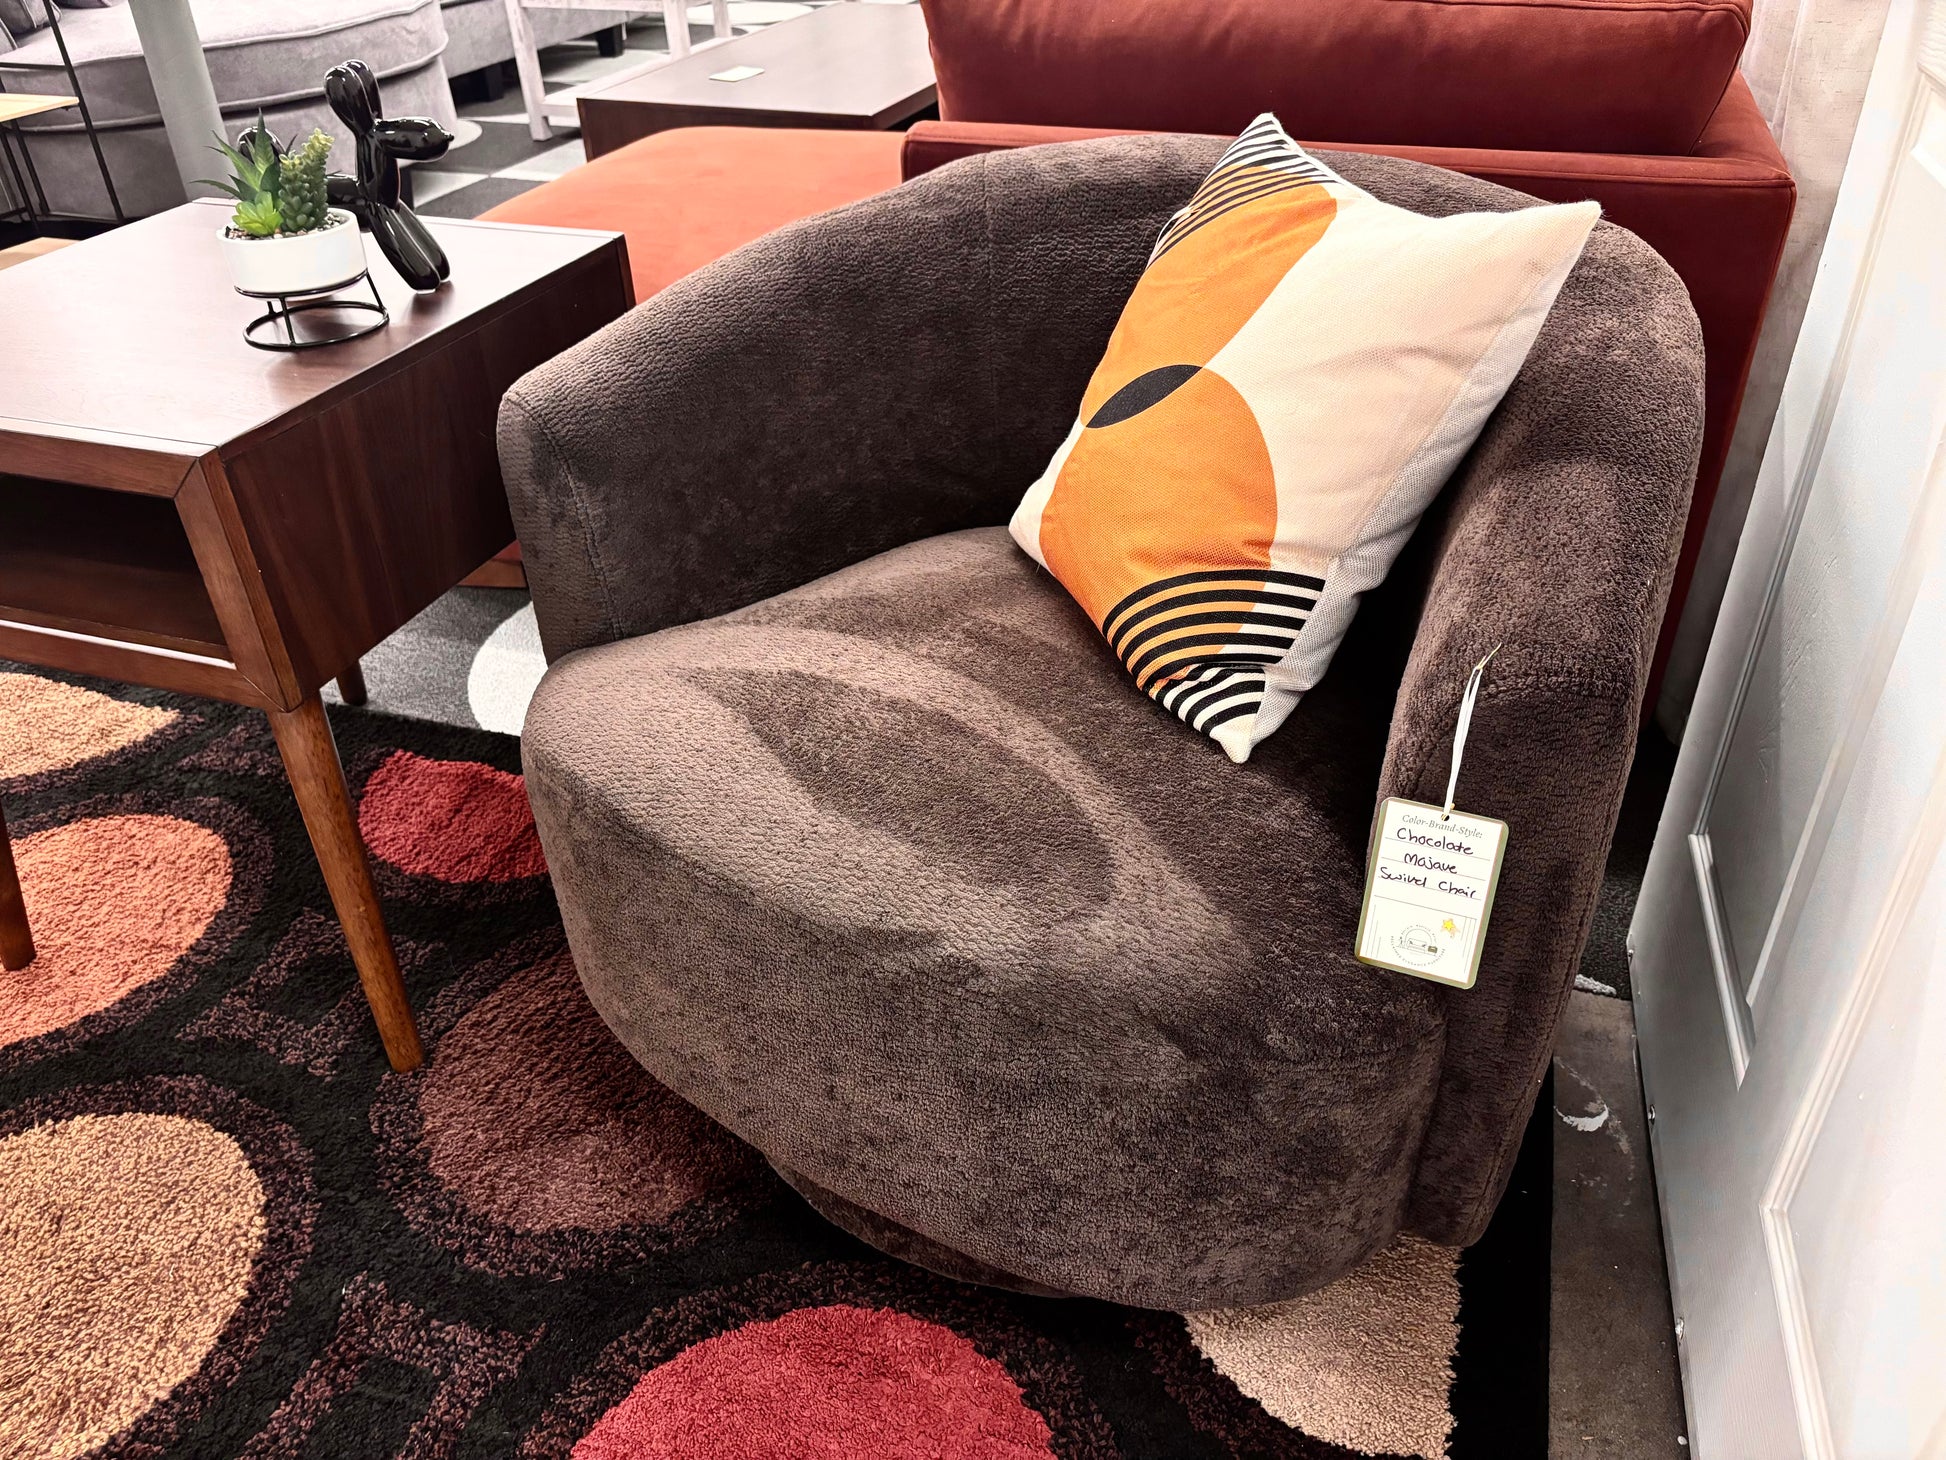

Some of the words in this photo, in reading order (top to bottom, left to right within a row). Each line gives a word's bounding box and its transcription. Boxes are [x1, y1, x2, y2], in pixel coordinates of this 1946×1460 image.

[1402, 814, 1483, 839] Color-Brand-Style:
[1397, 828, 1474, 855] Chocolate
[1380, 866, 1427, 888] Swivel
[1438, 880, 1477, 899] Chair
